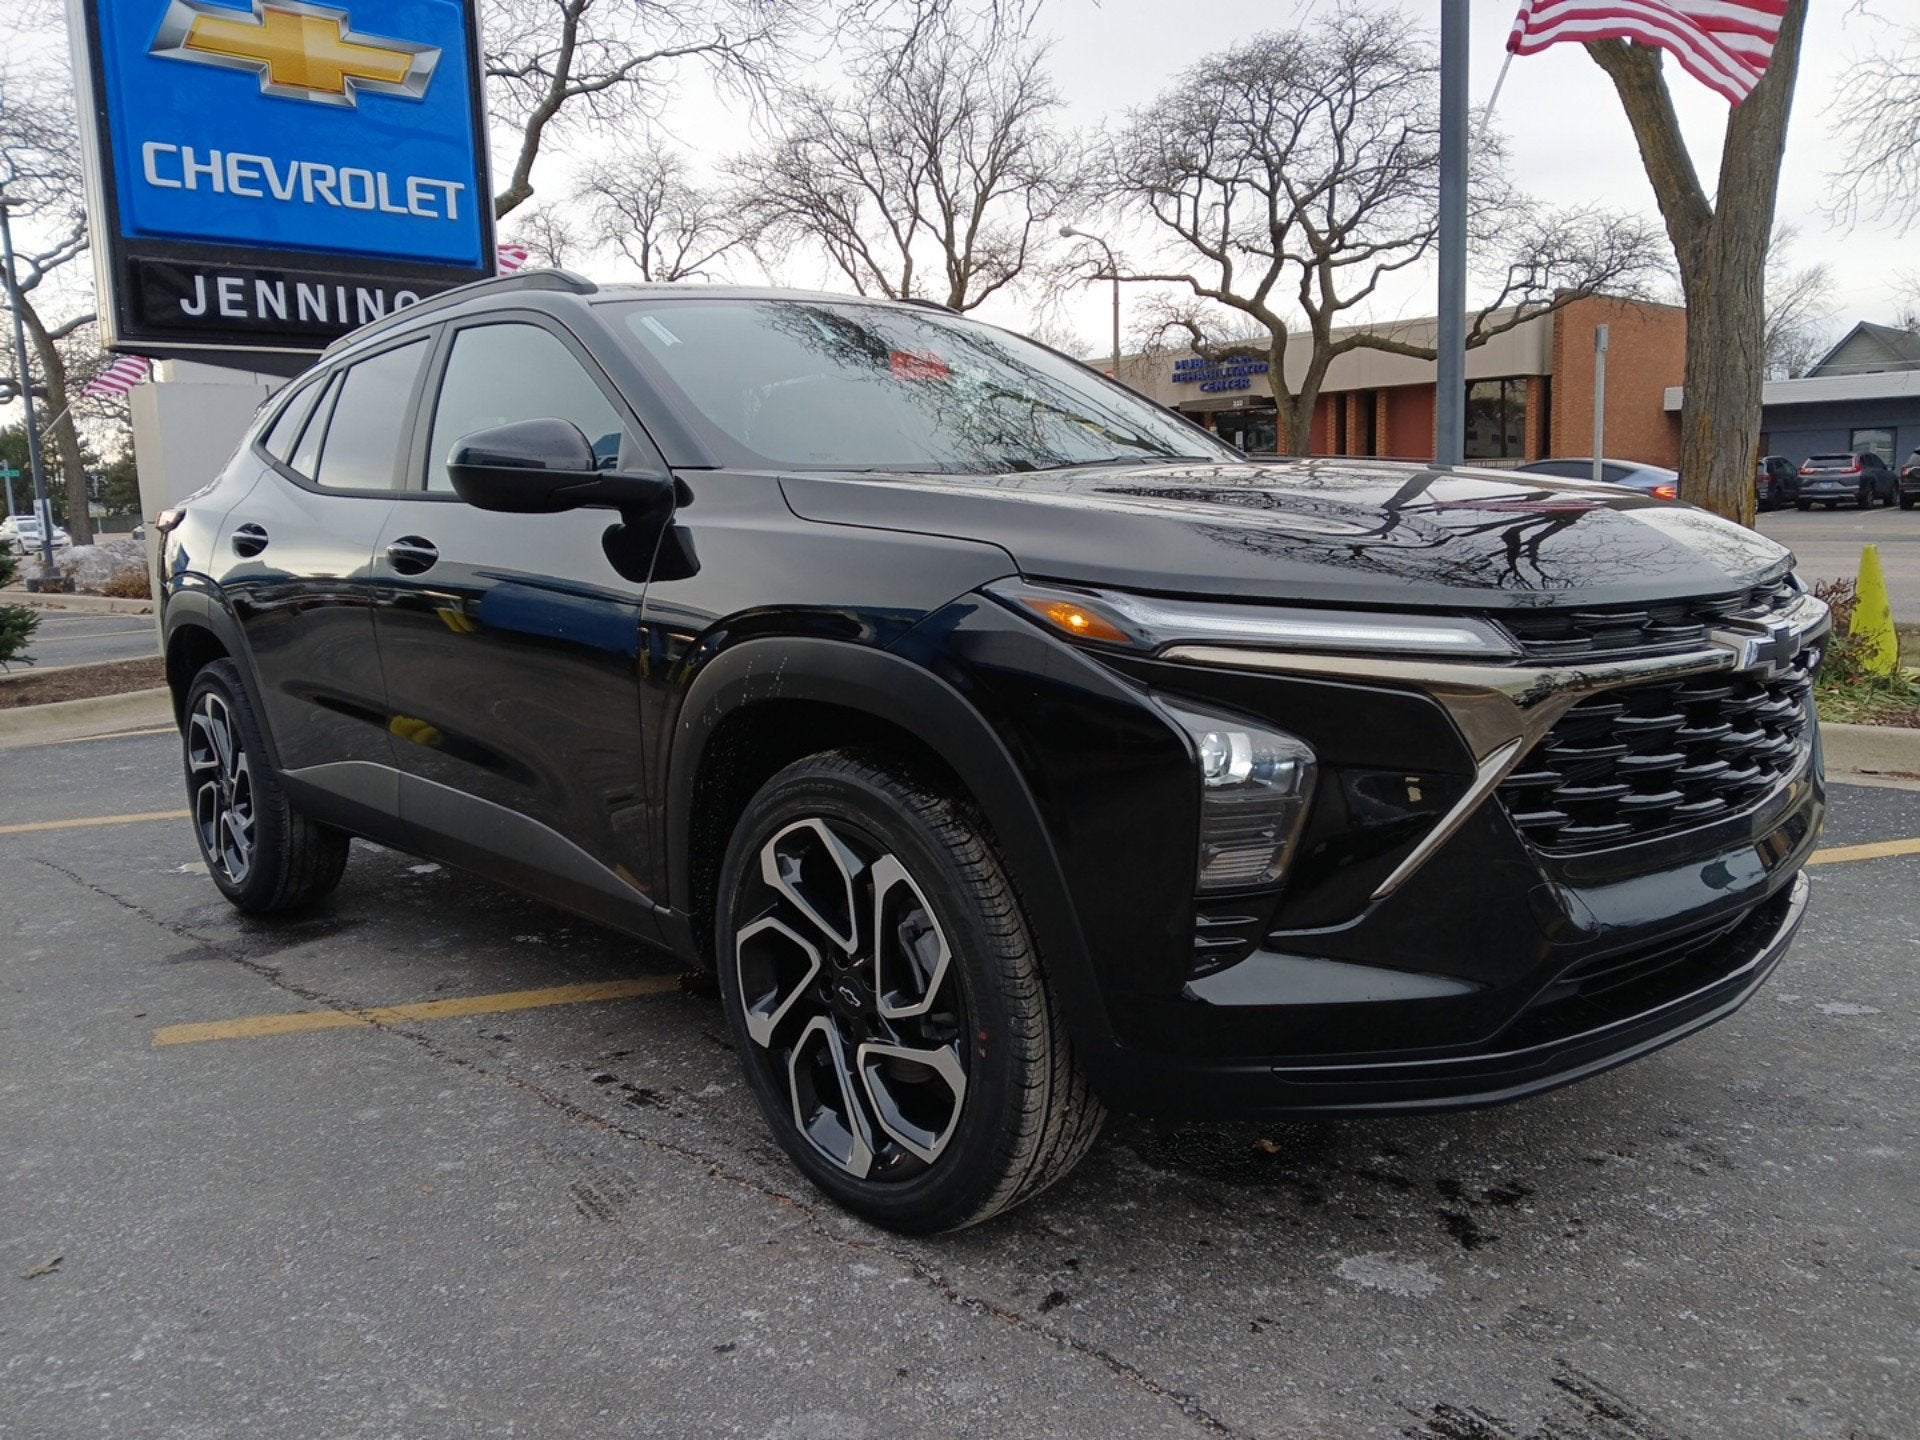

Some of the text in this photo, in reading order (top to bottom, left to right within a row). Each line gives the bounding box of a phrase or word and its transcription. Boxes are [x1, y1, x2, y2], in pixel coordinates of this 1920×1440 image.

[142, 141, 465, 220] CHEVROLET
[1172, 362, 1270, 384] REHABILITATIO
[1199, 377, 1251, 392] CENTER
